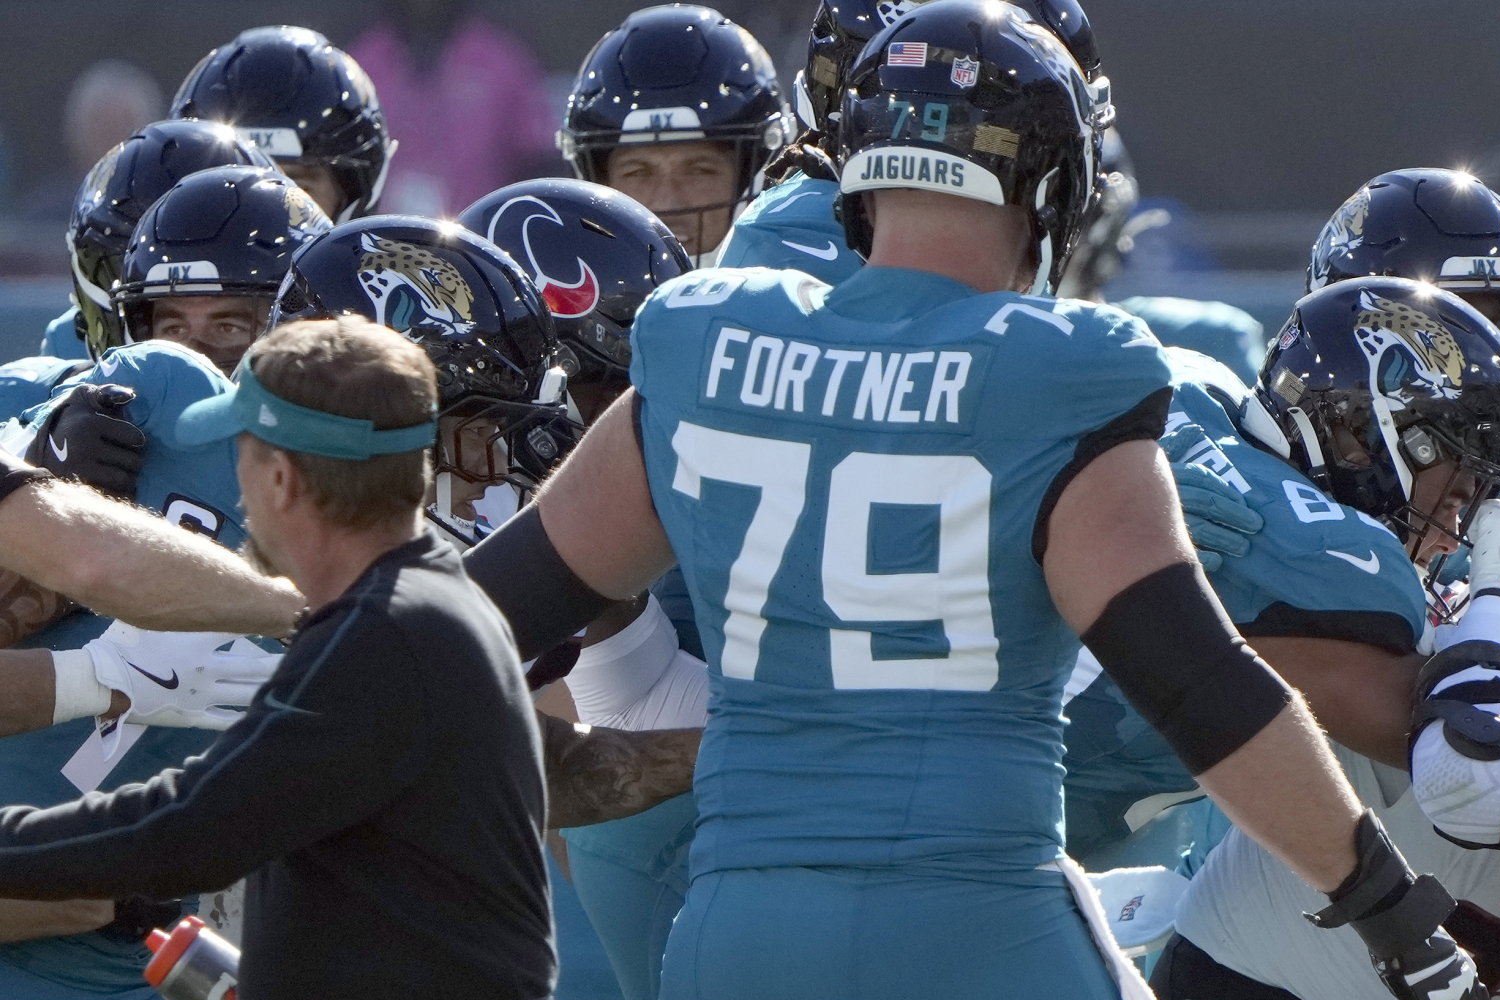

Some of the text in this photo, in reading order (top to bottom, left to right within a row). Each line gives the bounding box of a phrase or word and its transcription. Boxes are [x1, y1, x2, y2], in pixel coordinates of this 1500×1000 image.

[954, 69, 973, 84] NFL
[888, 101, 949, 143] 79
[861, 154, 965, 187] JAGUARS
[1468, 259, 1497, 276] JAX
[705, 326, 973, 424] FORTNER
[671, 420, 999, 692] 79
